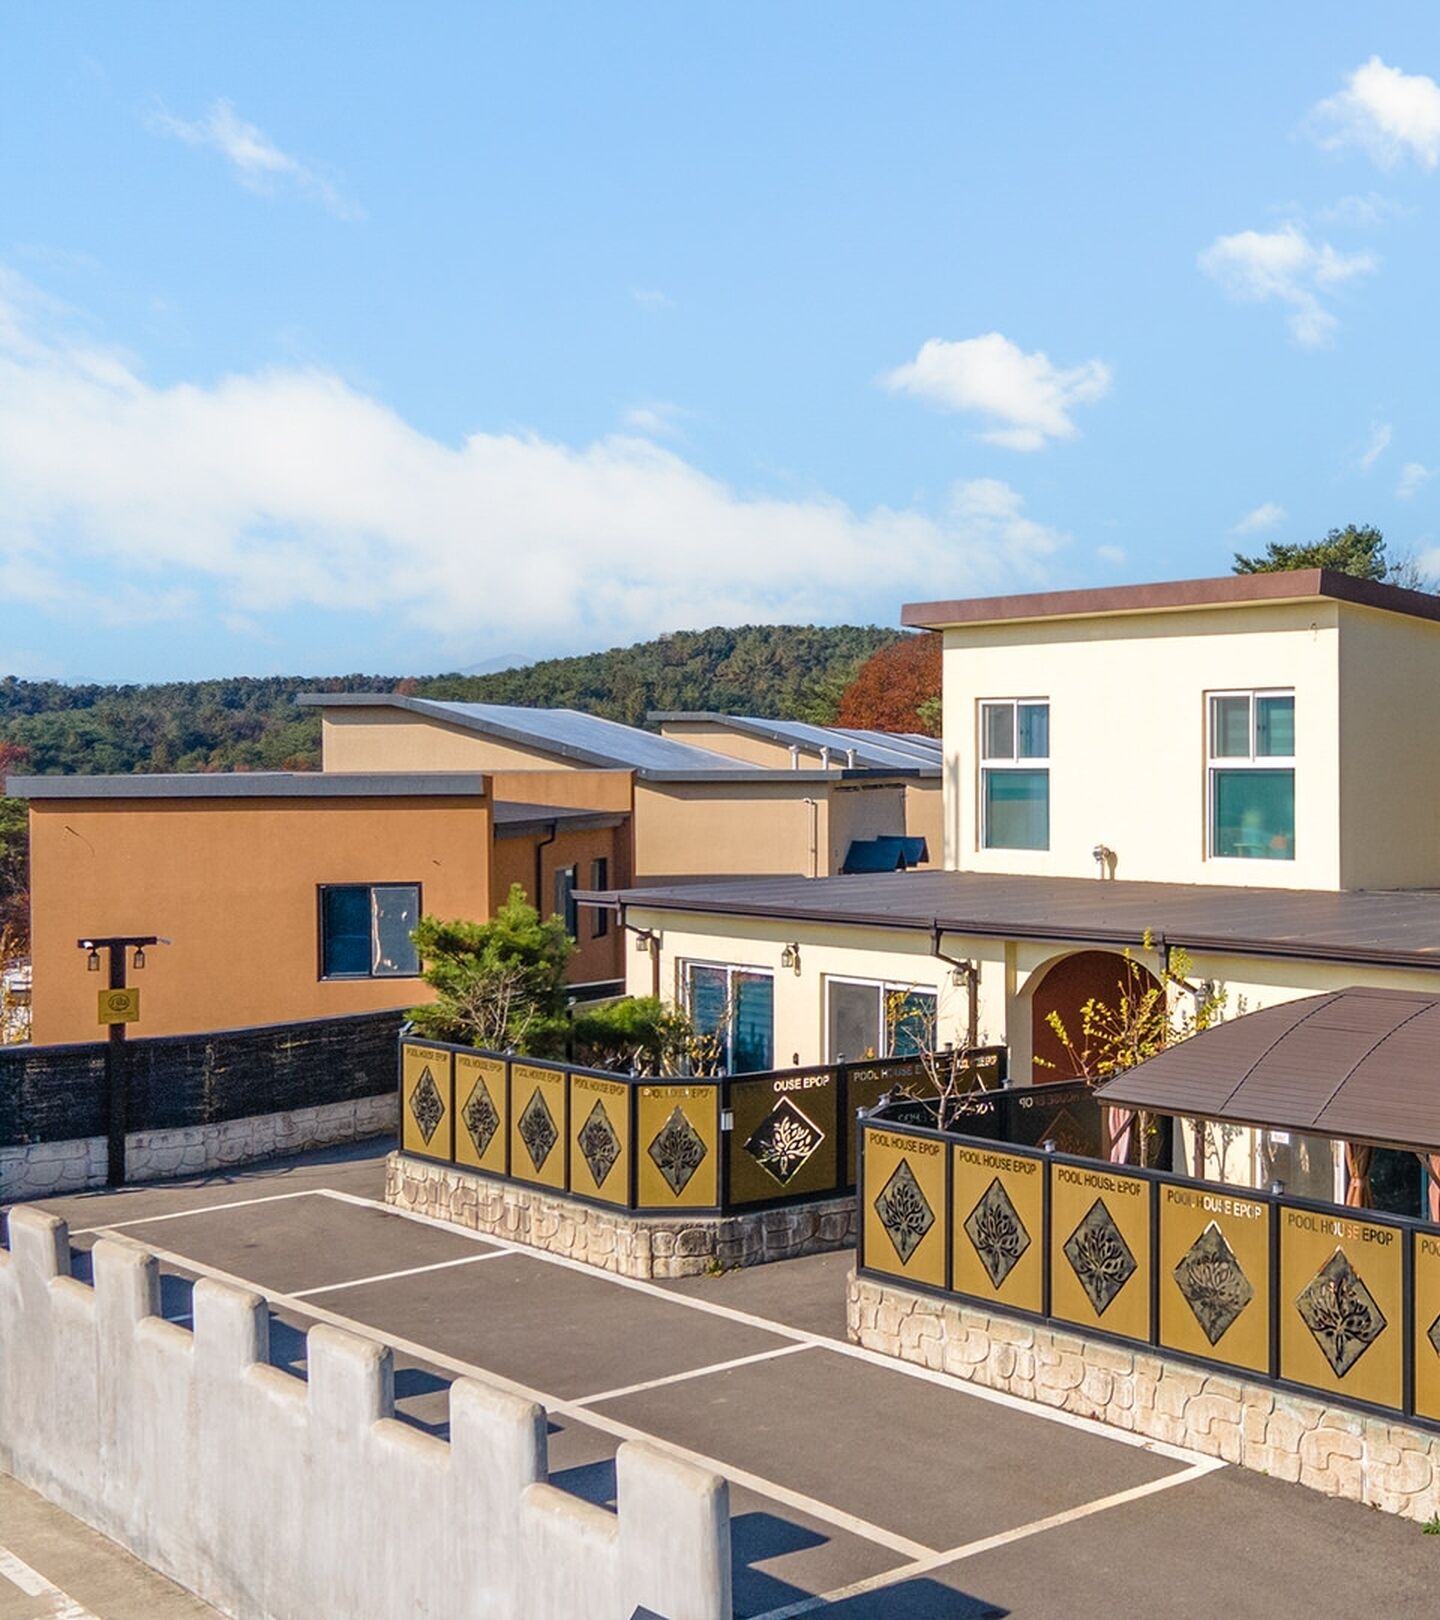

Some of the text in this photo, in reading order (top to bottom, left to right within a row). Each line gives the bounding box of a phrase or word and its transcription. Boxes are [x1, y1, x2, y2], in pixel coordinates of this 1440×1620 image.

[773, 1075, 830, 1092] OUSE EPOP
[869, 1133, 940, 1156] POOL HOUSE EPOP
[959, 1150, 1037, 1175] POOL HOUSE EPOP
[1058, 1169, 1083, 1186] POOL
[1084, 1174, 1116, 1192] HOUSE
[1233, 1201, 1262, 1220] EPOP
[1287, 1213, 1394, 1246] POOL HOUSE EPOP
